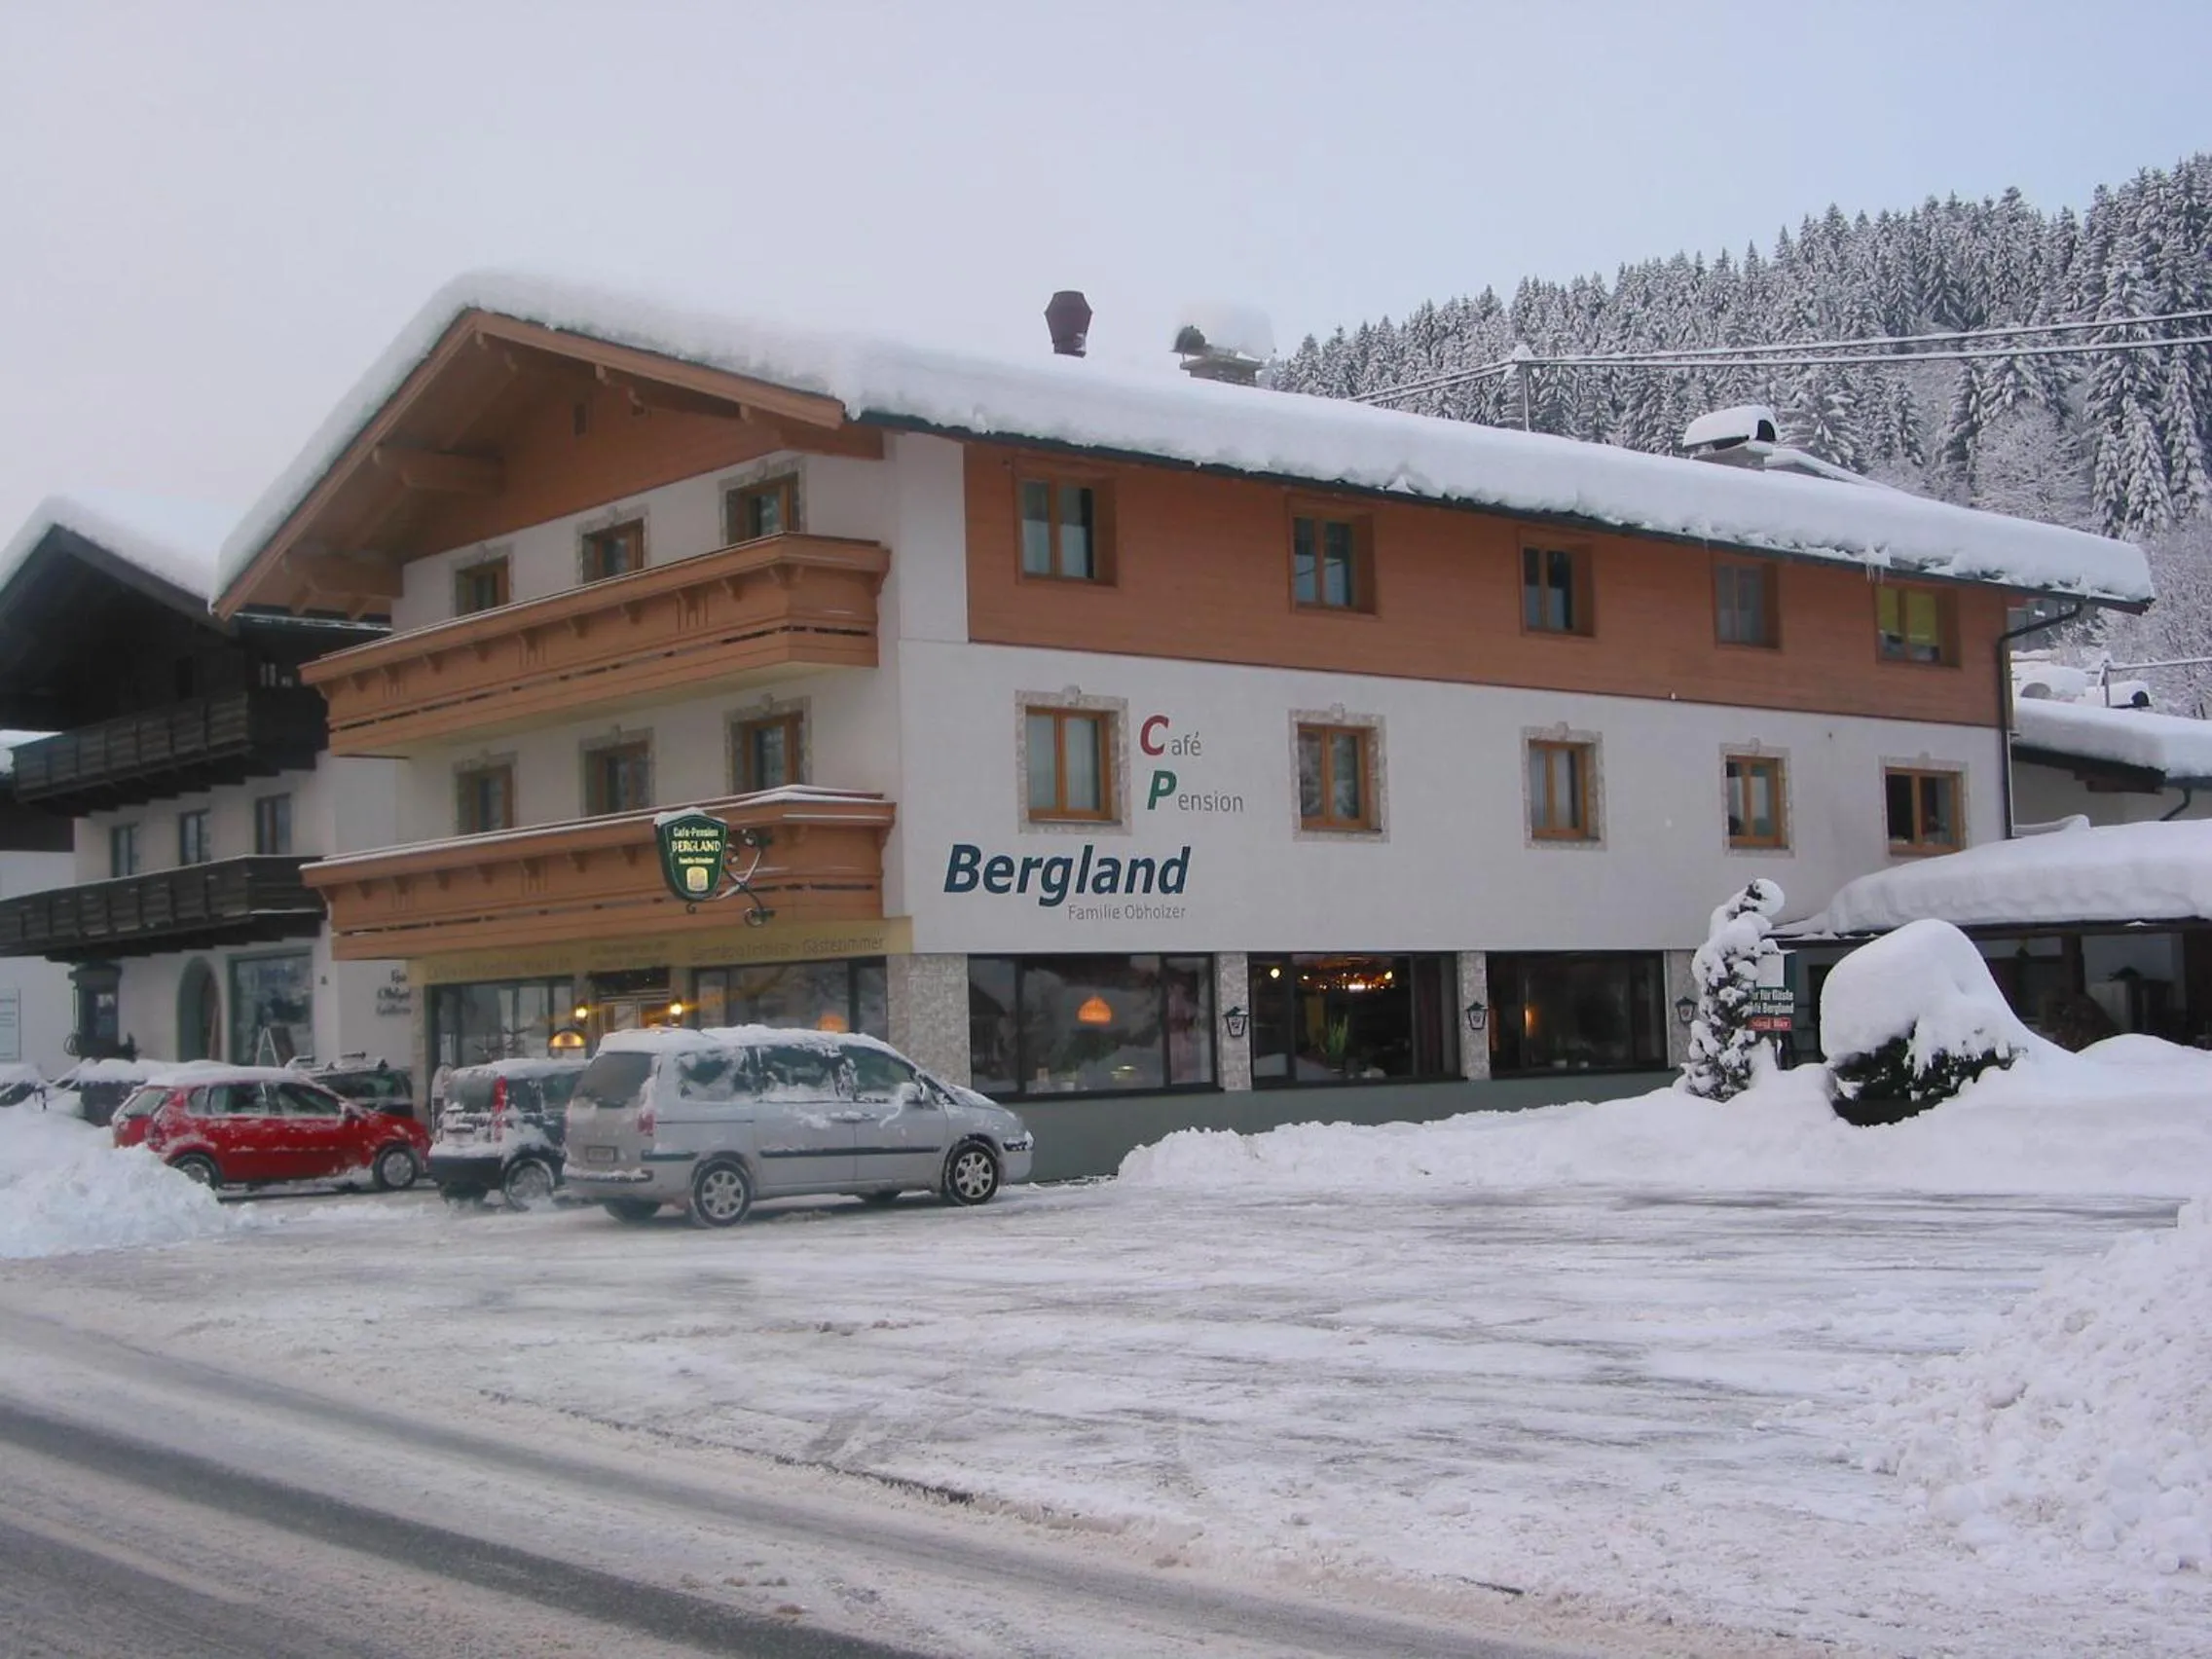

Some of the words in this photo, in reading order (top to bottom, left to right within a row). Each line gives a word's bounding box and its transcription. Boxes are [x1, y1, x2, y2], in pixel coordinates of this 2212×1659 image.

[1140, 715, 1201, 756] Café
[1147, 770, 1243, 812] Pension
[671, 840, 721, 852] BERGLAND
[943, 844, 1191, 907] Bergland
[1068, 904, 1121, 920] Familie
[1124, 903, 1186, 920] Obholzer
